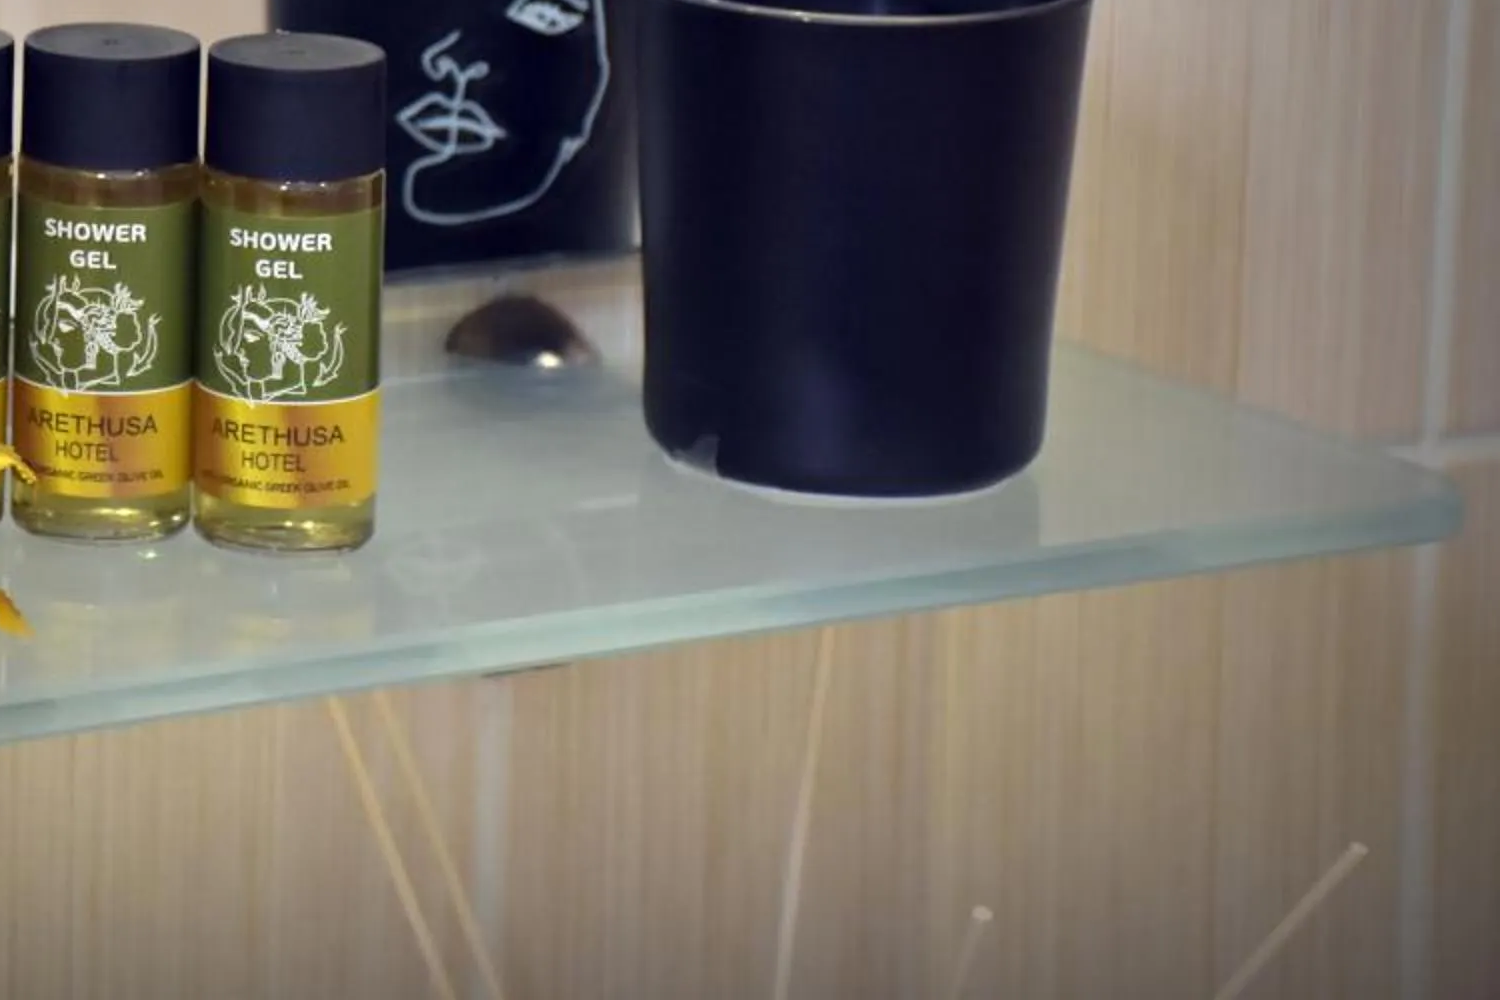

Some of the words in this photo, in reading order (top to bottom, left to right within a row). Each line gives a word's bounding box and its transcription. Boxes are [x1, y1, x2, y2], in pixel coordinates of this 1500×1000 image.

[43, 217, 147, 243] SHOWER
[229, 226, 333, 253] SHOWER
[69, 249, 117, 270] GEL
[255, 258, 304, 280] GEL
[27, 406, 159, 438] ARETHUSA
[211, 417, 346, 448] ARETHUSA
[54, 438, 120, 463] HOTEL
[241, 450, 306, 473] HOTEL
